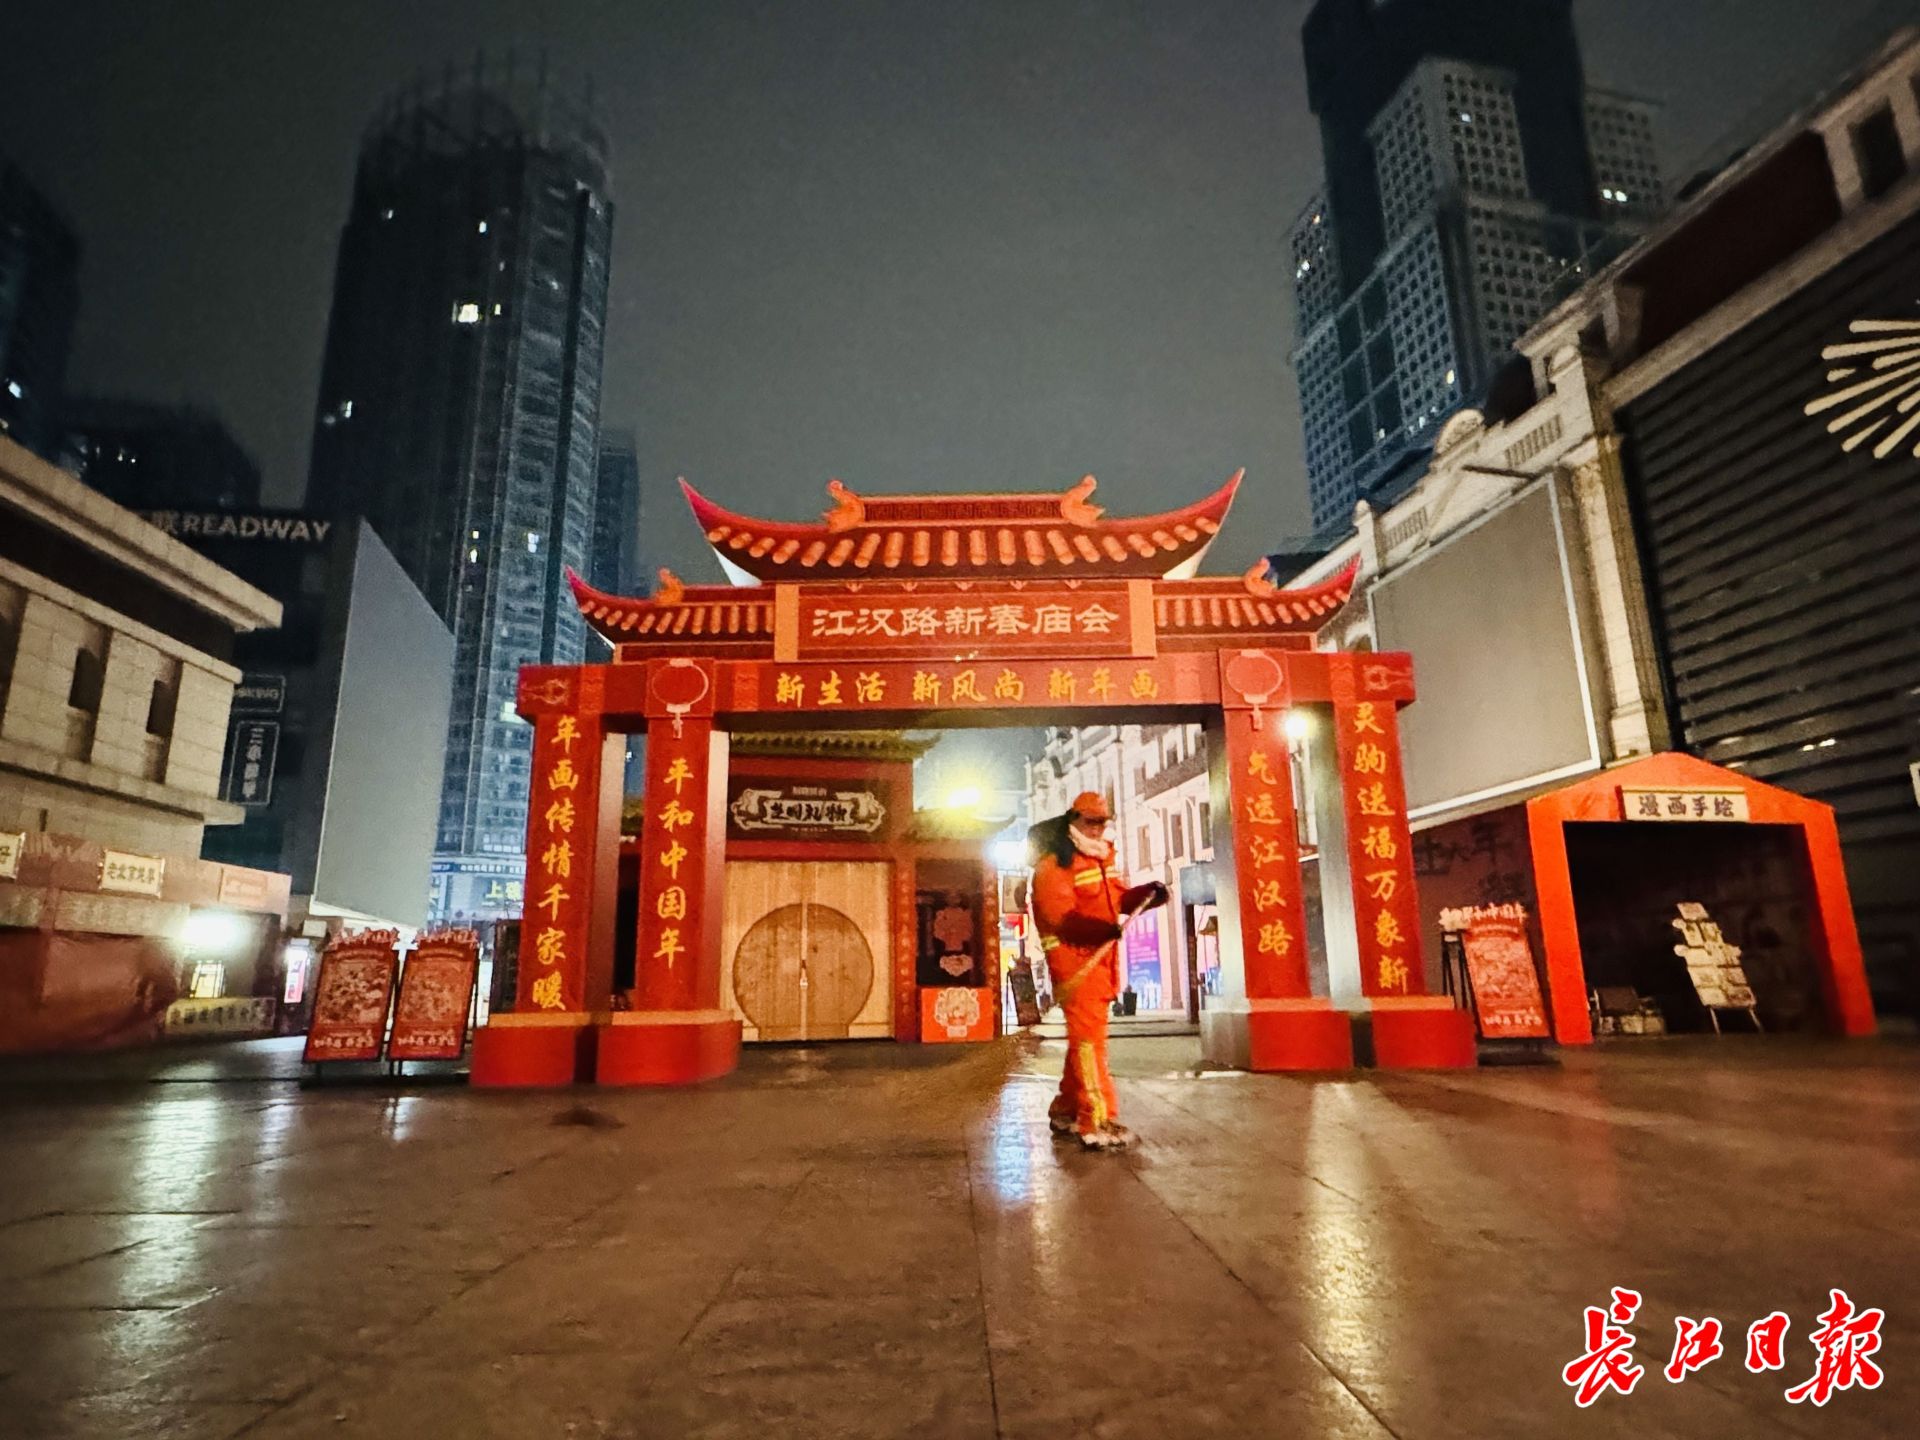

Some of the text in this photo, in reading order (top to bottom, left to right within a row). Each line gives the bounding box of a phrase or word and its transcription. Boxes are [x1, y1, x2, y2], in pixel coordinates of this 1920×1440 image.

[776, 667, 1159, 708] 新生活 新风尚 新年画
[811, 603, 1119, 637] 江汉路新春庙会
[532, 714, 582, 1012] 年画传情千家暖
[653, 757, 695, 970] 平和中国年
[1246, 750, 1294, 956] 气运江汉路
[1352, 701, 1409, 995] 灵驹送福万象新
[1638, 793, 1735, 818] 漫画手绘
